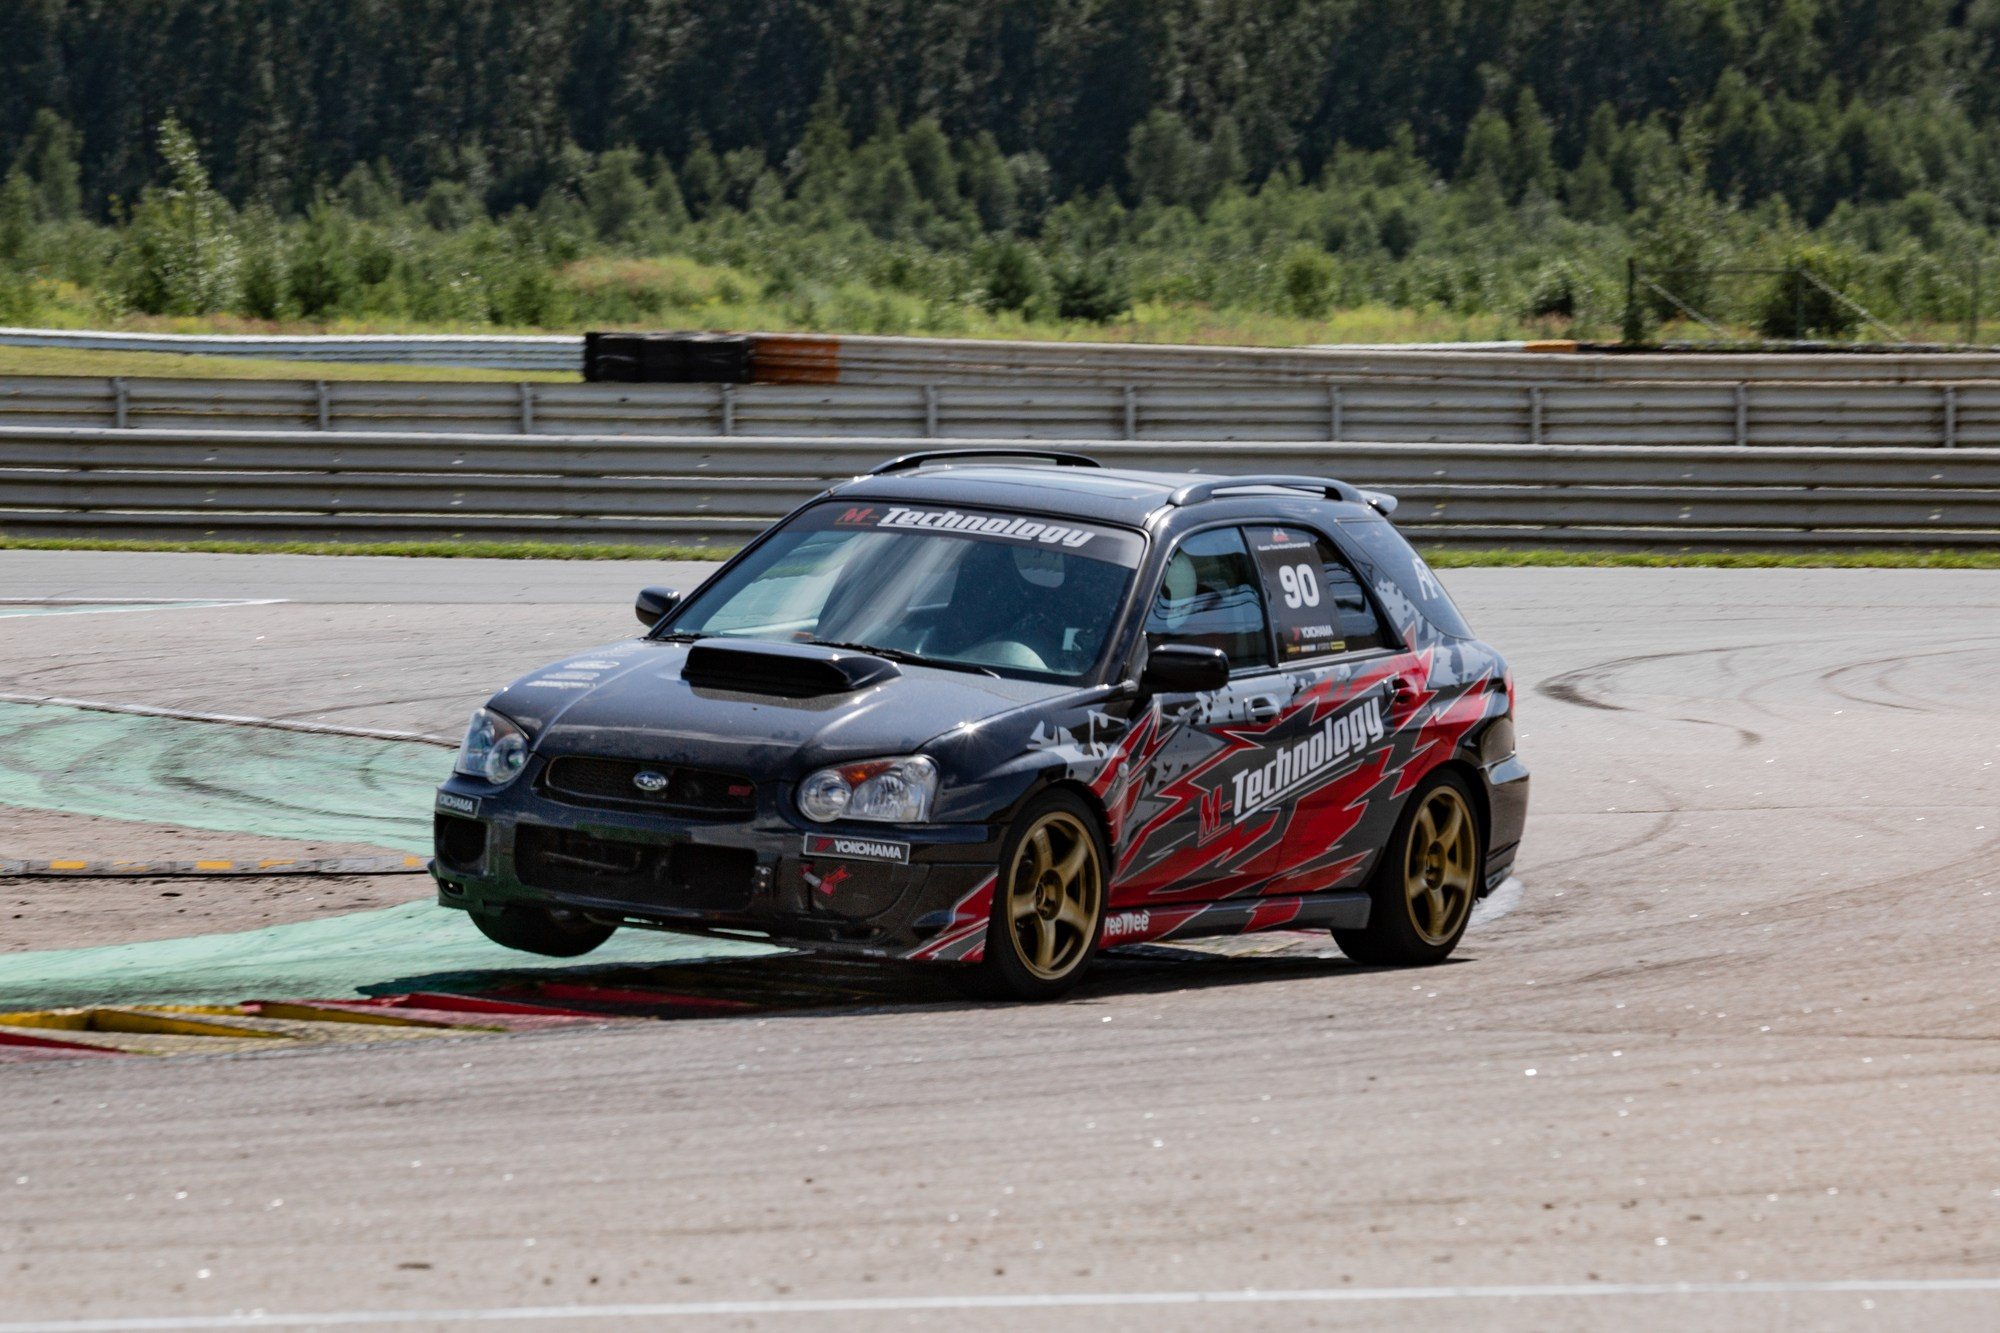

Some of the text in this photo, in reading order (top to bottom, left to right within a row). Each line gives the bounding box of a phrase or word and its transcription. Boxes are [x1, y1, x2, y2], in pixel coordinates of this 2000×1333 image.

[834, 507, 1095, 547] M-Technology
[1279, 563, 1319, 609] 90
[1301, 625, 1334, 638] YOKOHAMA
[1198, 697, 1385, 848] M-Technology
[834, 839, 902, 859] YOKOHAMA
